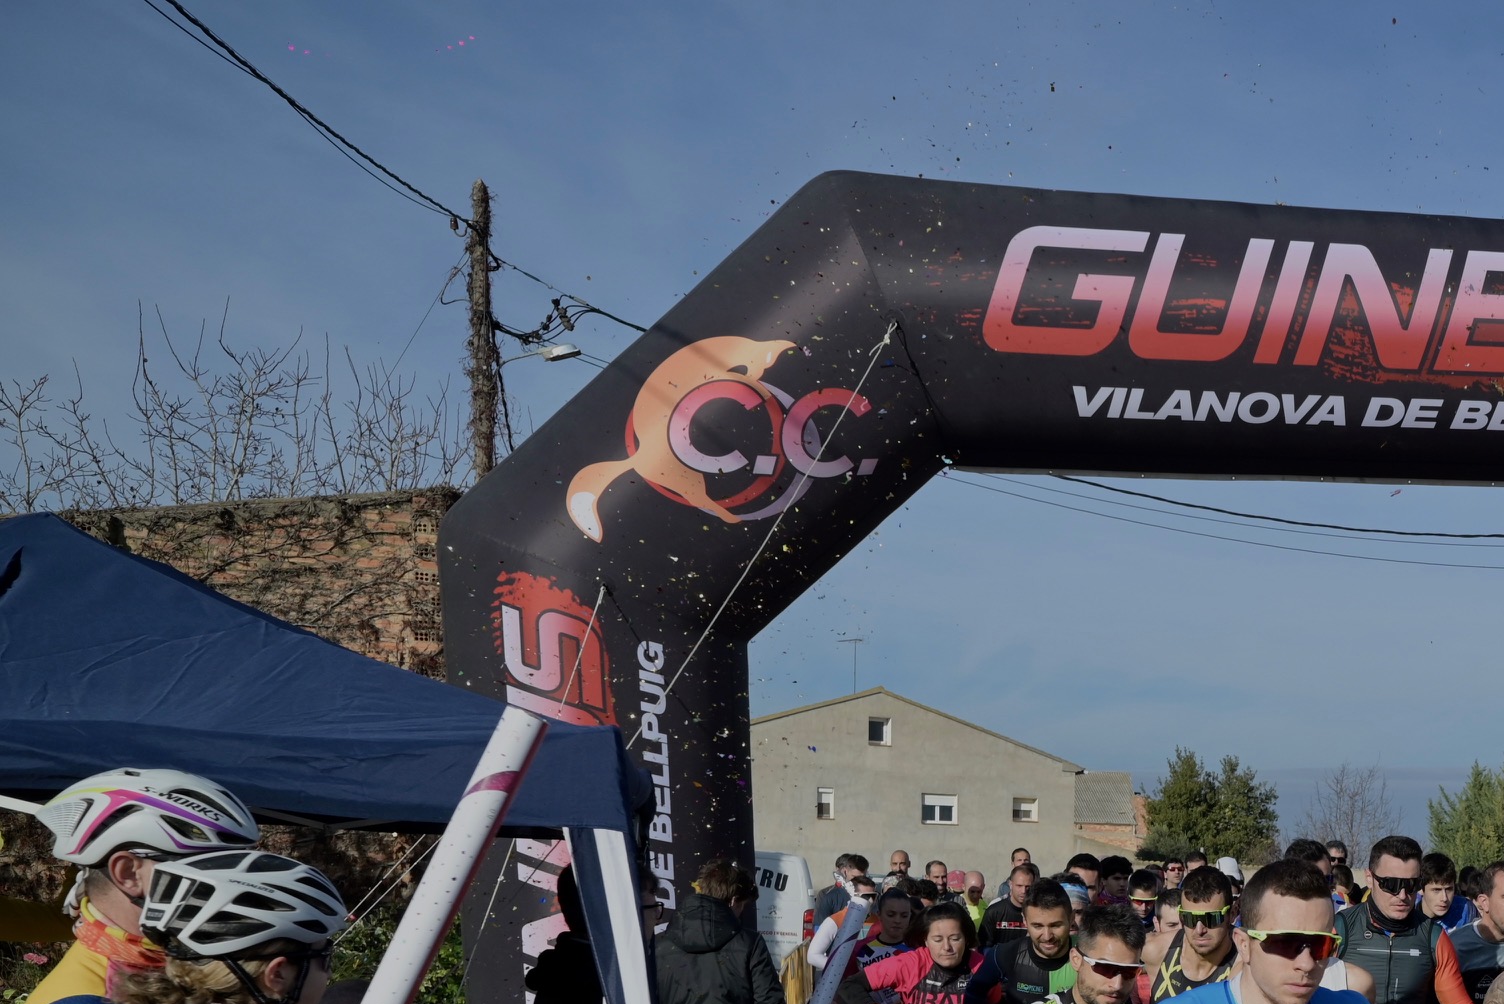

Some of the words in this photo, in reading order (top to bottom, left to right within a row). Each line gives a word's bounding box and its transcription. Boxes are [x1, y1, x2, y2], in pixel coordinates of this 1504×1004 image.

[1072, 386, 1348, 427] VILANOVA
[1361, 397, 1446, 431] DE
[637, 640, 672, 843] BELLPUIG
[140, 786, 225, 822] S-WORKS
[229, 879, 276, 894] SPECIALIZED
